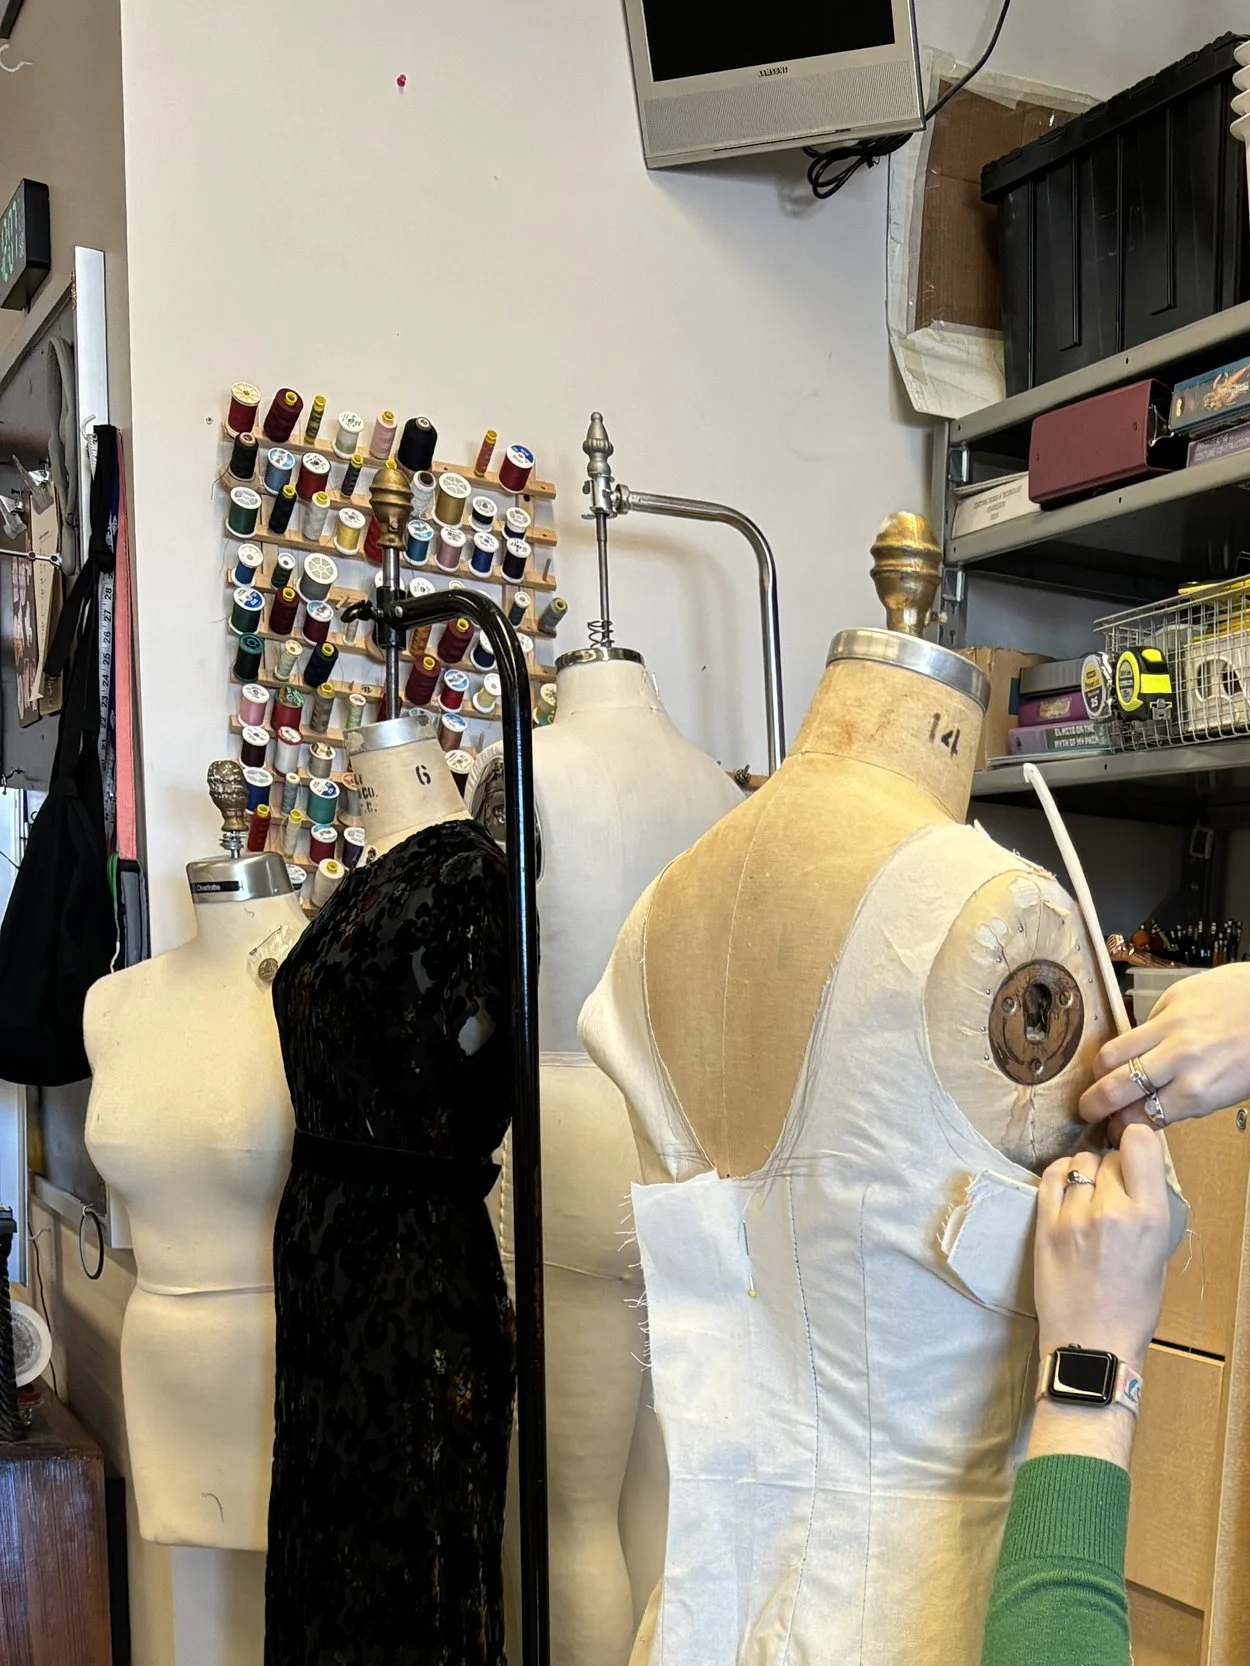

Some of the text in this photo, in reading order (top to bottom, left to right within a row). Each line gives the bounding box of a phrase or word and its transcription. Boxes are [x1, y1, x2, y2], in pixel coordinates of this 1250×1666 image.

[104, 587, 113, 600] 28
[103, 609, 112, 622] 27
[103, 631, 111, 644] 26
[103, 652, 110, 665] 25
[102, 674, 109, 687] 24
[101, 696, 108, 708] 23
[928, 712, 961, 760] 14
[415, 765, 431, 785] 6
